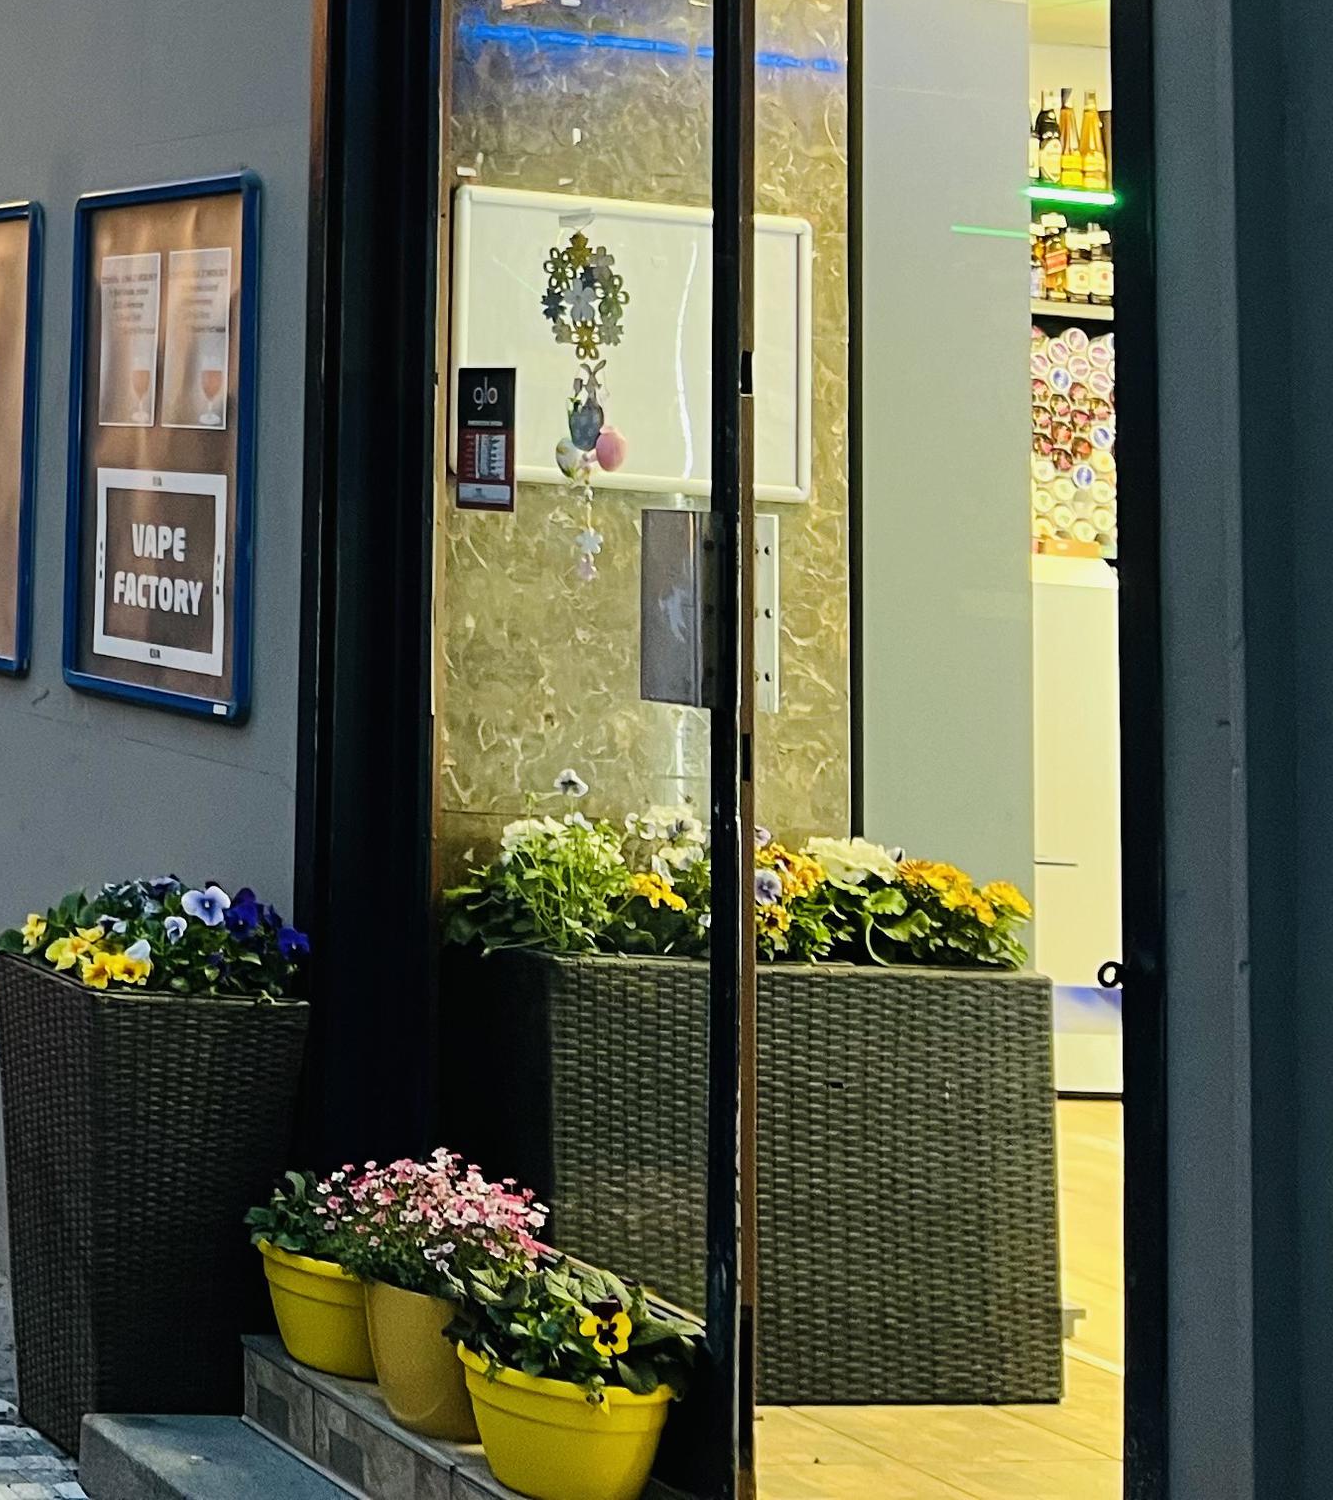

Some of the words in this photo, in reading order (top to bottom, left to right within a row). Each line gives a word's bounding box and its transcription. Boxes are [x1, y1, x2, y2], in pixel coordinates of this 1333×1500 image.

[472, 375, 499, 411] glo
[131, 522, 187, 563] VAPE
[113, 570, 204, 617] FACTORY
